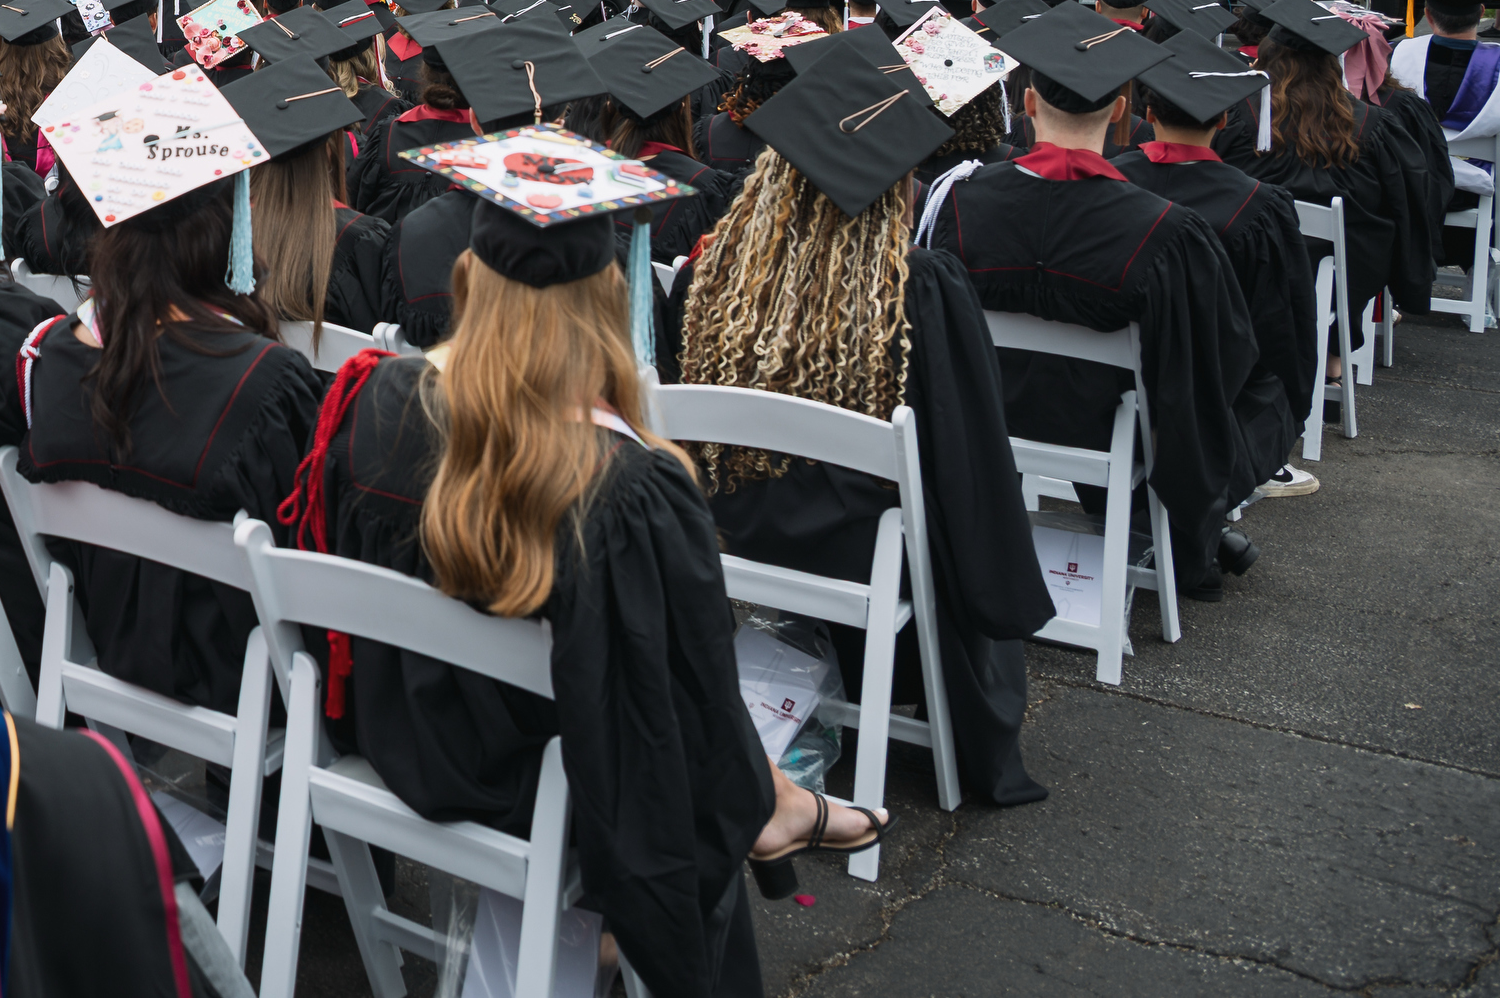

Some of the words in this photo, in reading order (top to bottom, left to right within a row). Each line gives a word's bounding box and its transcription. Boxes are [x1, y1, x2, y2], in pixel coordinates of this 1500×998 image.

[147, 143, 229, 161] Sprouse
[1049, 569, 1067, 577] INDIANA
[1068, 573, 1094, 581] UNIVERSITY
[760, 702, 779, 714] INDIANA
